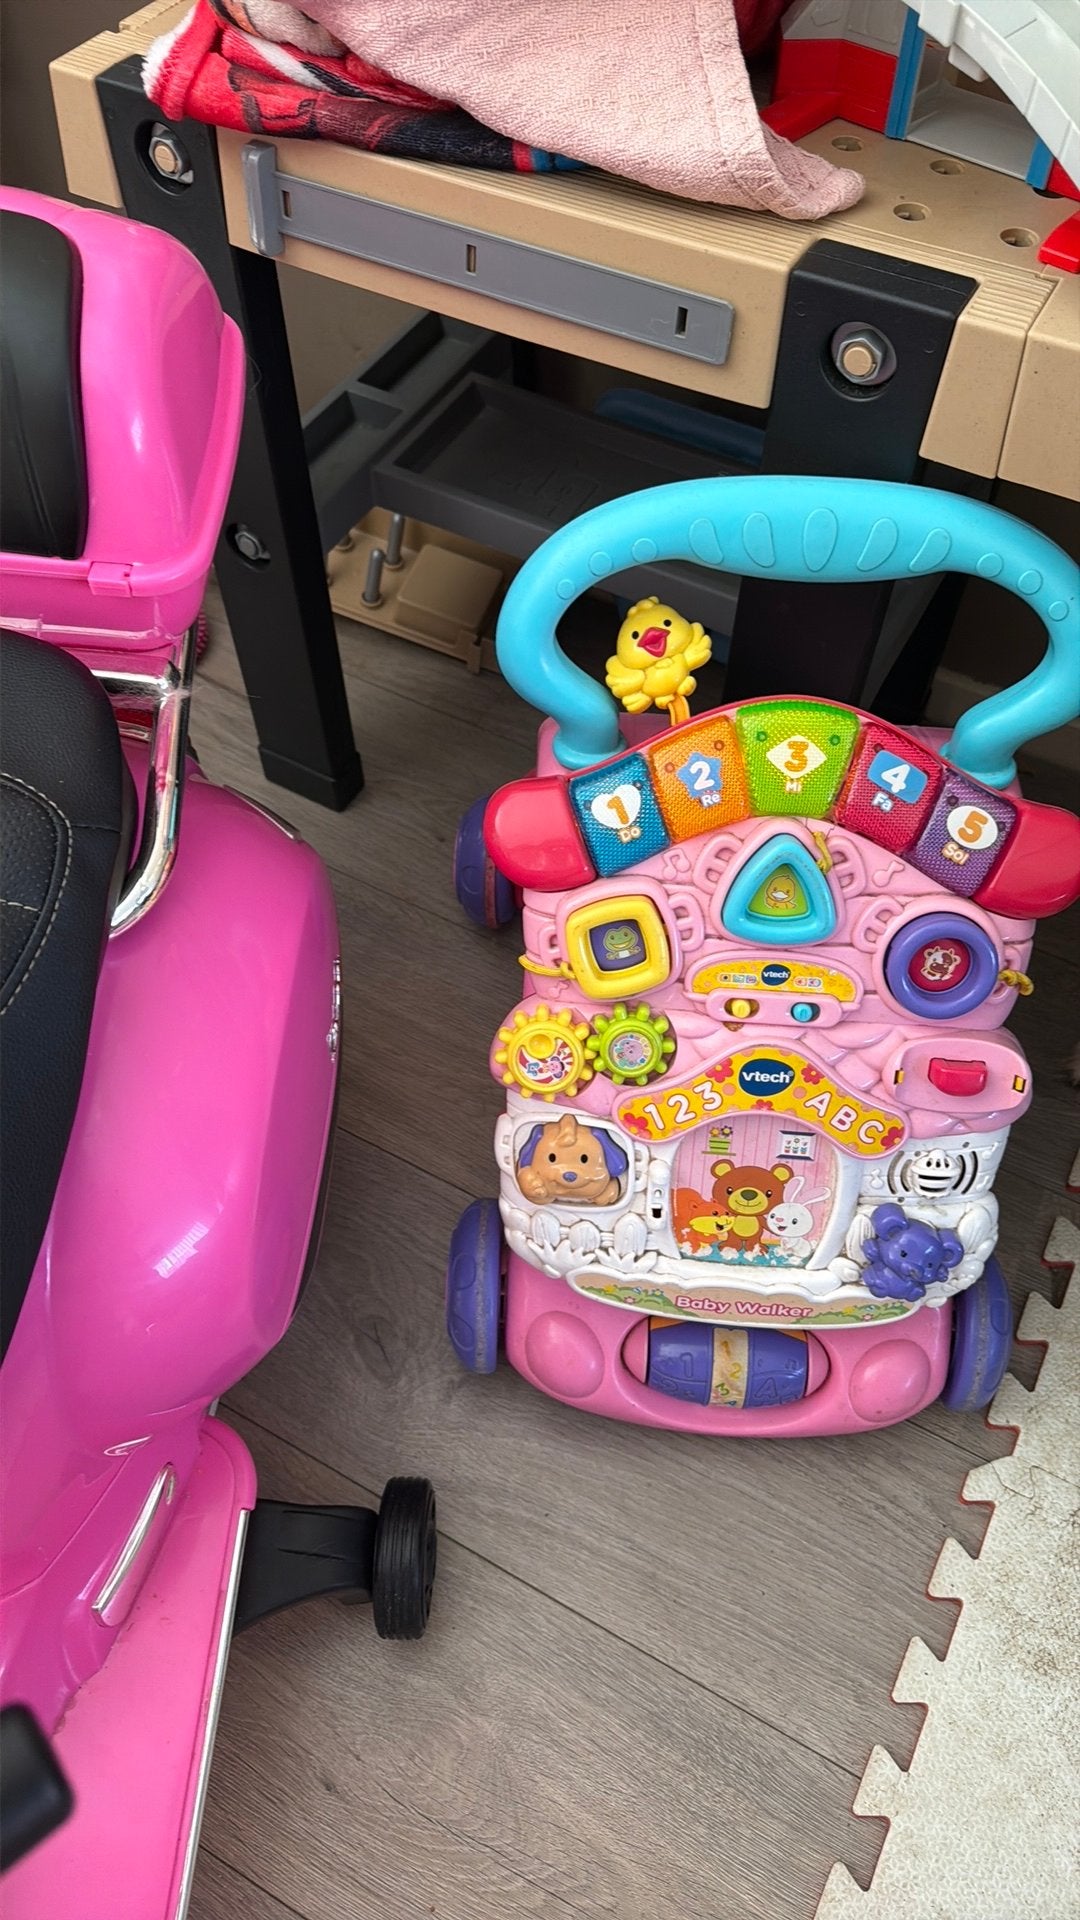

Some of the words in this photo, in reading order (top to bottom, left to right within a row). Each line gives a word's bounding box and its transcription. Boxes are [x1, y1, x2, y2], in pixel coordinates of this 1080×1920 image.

[784, 740, 809, 772] 3
[690, 761, 715, 790] 2
[881, 764, 911, 793] 4
[607, 795, 630, 825] 1
[872, 792, 892, 812] Fa
[619, 827, 640, 843] Do
[957, 810, 989, 844] 5
[943, 842, 969, 865] Sol
[763, 970, 790, 979] vtech
[742, 1071, 790, 1083] vtech
[803, 1091, 885, 1144] ABC
[676, 1296, 730, 1313] Baby
[735, 1302, 812, 1317] Walker
